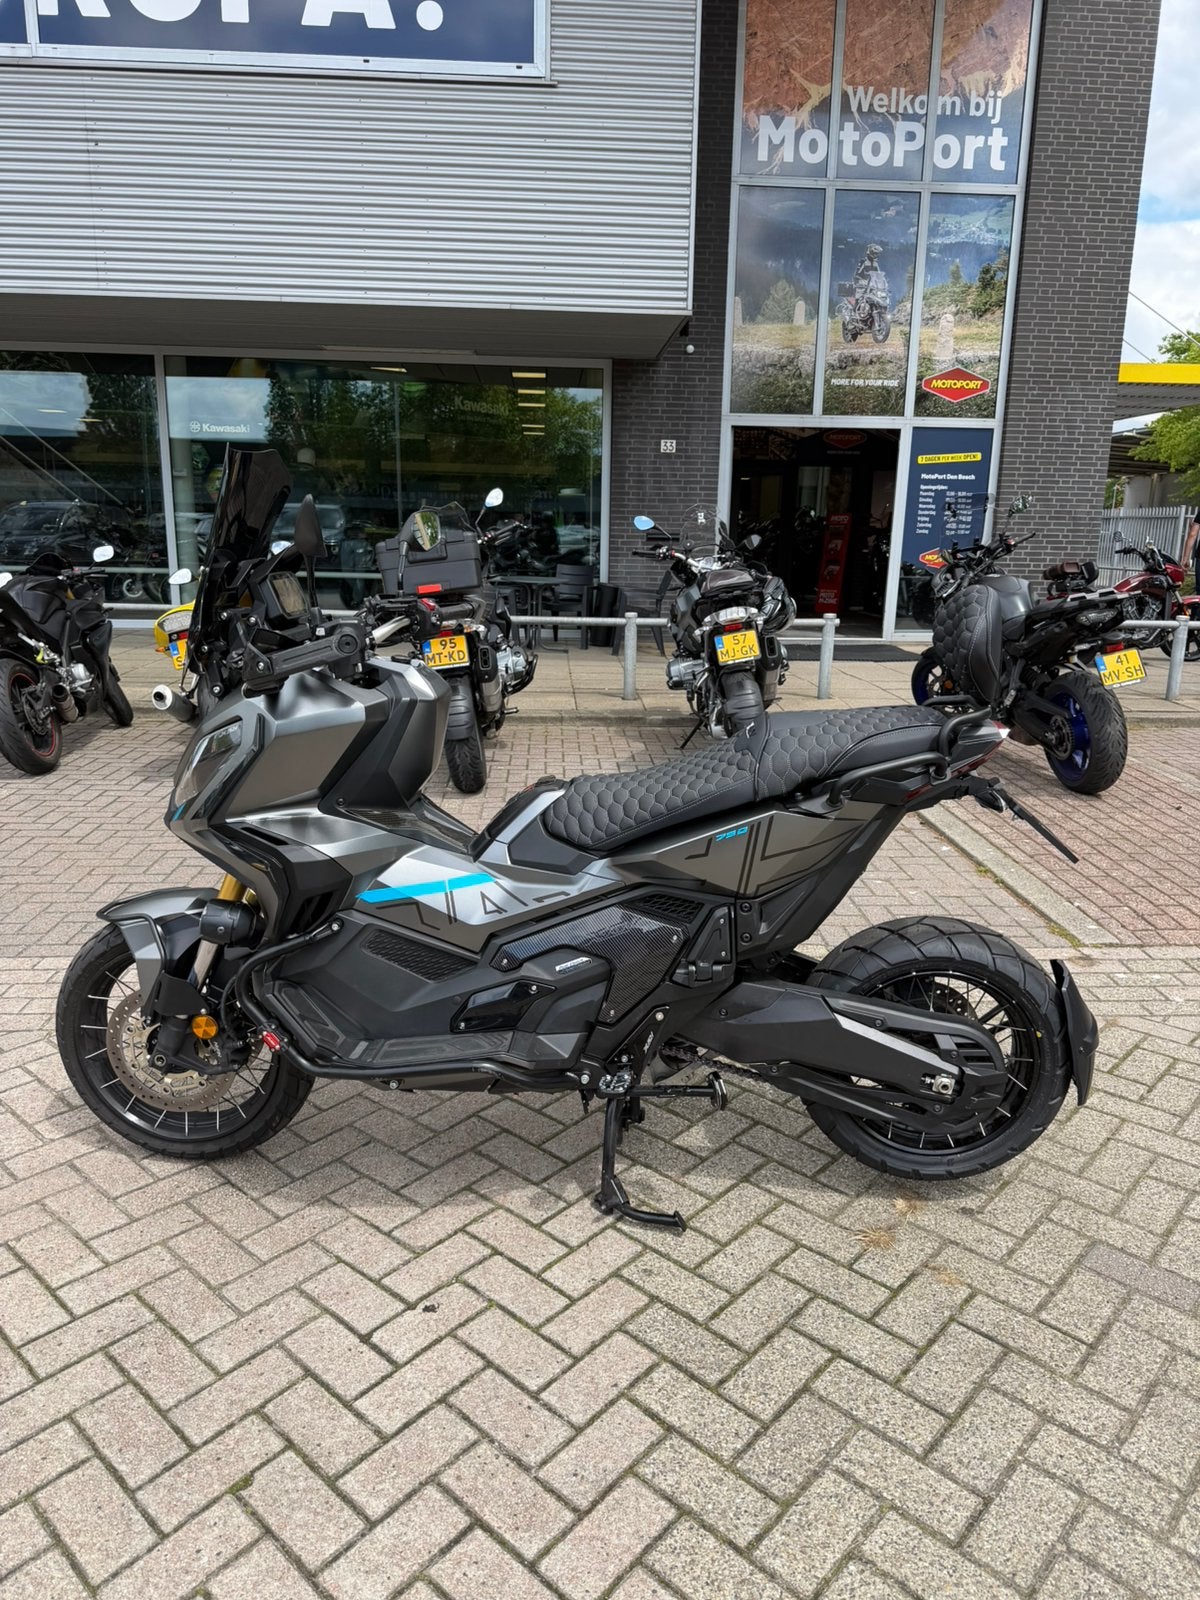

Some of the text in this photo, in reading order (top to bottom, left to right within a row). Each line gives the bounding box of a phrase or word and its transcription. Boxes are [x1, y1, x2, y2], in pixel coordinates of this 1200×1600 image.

[849, 85, 1002, 124] Welkom bij
[757, 115, 1008, 171] MotoPort
[831, 378, 850, 386] MORE
[865, 379, 883, 387] YOUR
[930, 379, 983, 390] MOTOPORT
[202, 423, 250, 433] Kawasaki
[662, 441, 675, 452] 33
[439, 638, 457, 650] 95
[732, 634, 747, 645] 57
[426, 650, 466, 665] MT-KD
[720, 644, 757, 660] MJ-GK
[1116, 654, 1130, 666] 41
[1102, 665, 1144, 684] MV-SH
[715, 826, 749, 841] 750
